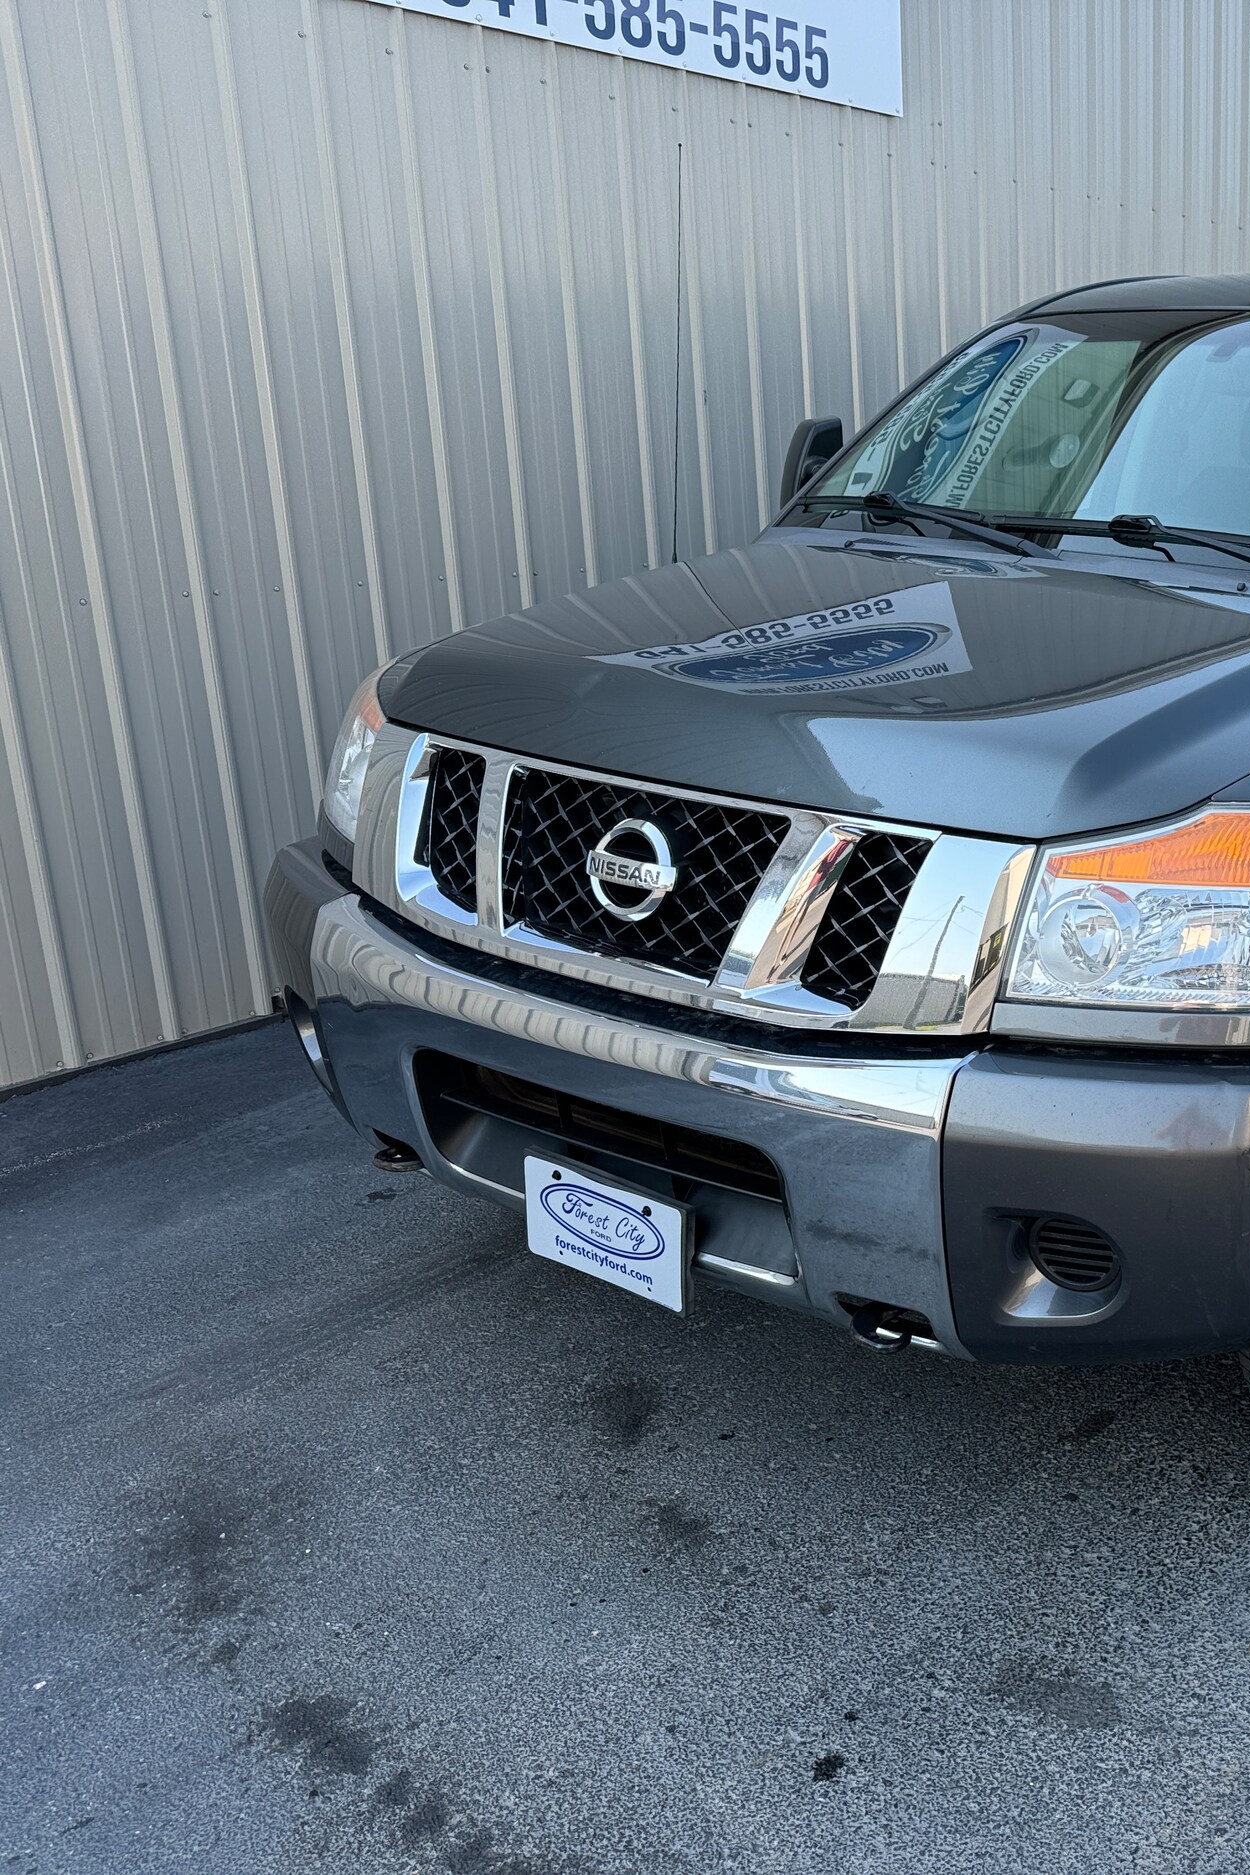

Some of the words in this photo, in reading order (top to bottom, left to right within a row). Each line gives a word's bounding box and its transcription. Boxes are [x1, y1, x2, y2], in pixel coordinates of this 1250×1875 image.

[590, 857, 661, 886] NISSAN
[561, 1192, 610, 1231] Forest
[614, 1216, 646, 1252] City
[589, 1228, 613, 1243] FORD
[555, 1234, 653, 1286] forestcityford.com
